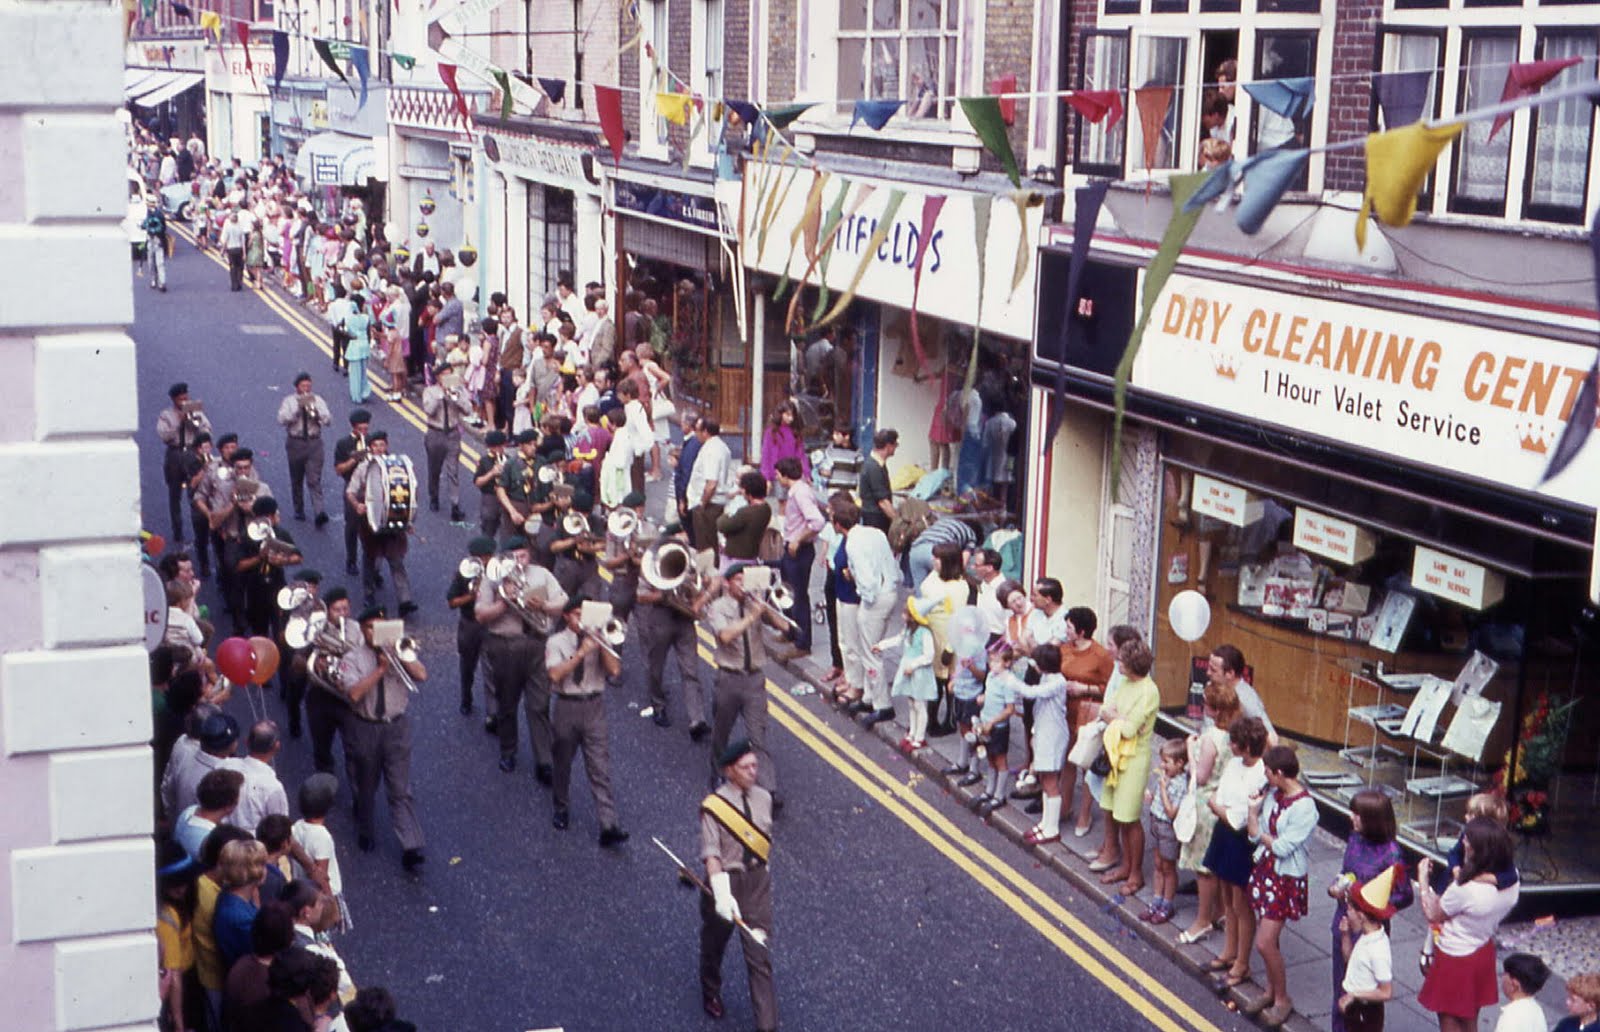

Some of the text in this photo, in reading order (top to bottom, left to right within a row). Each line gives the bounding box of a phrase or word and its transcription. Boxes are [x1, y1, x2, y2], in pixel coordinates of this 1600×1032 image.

[1162, 293, 1600, 429] DRY CLEANING CENT
[1276, 372, 1321, 405] Hour
[1333, 385, 1383, 422] Valet
[1396, 399, 1482, 446] Service
